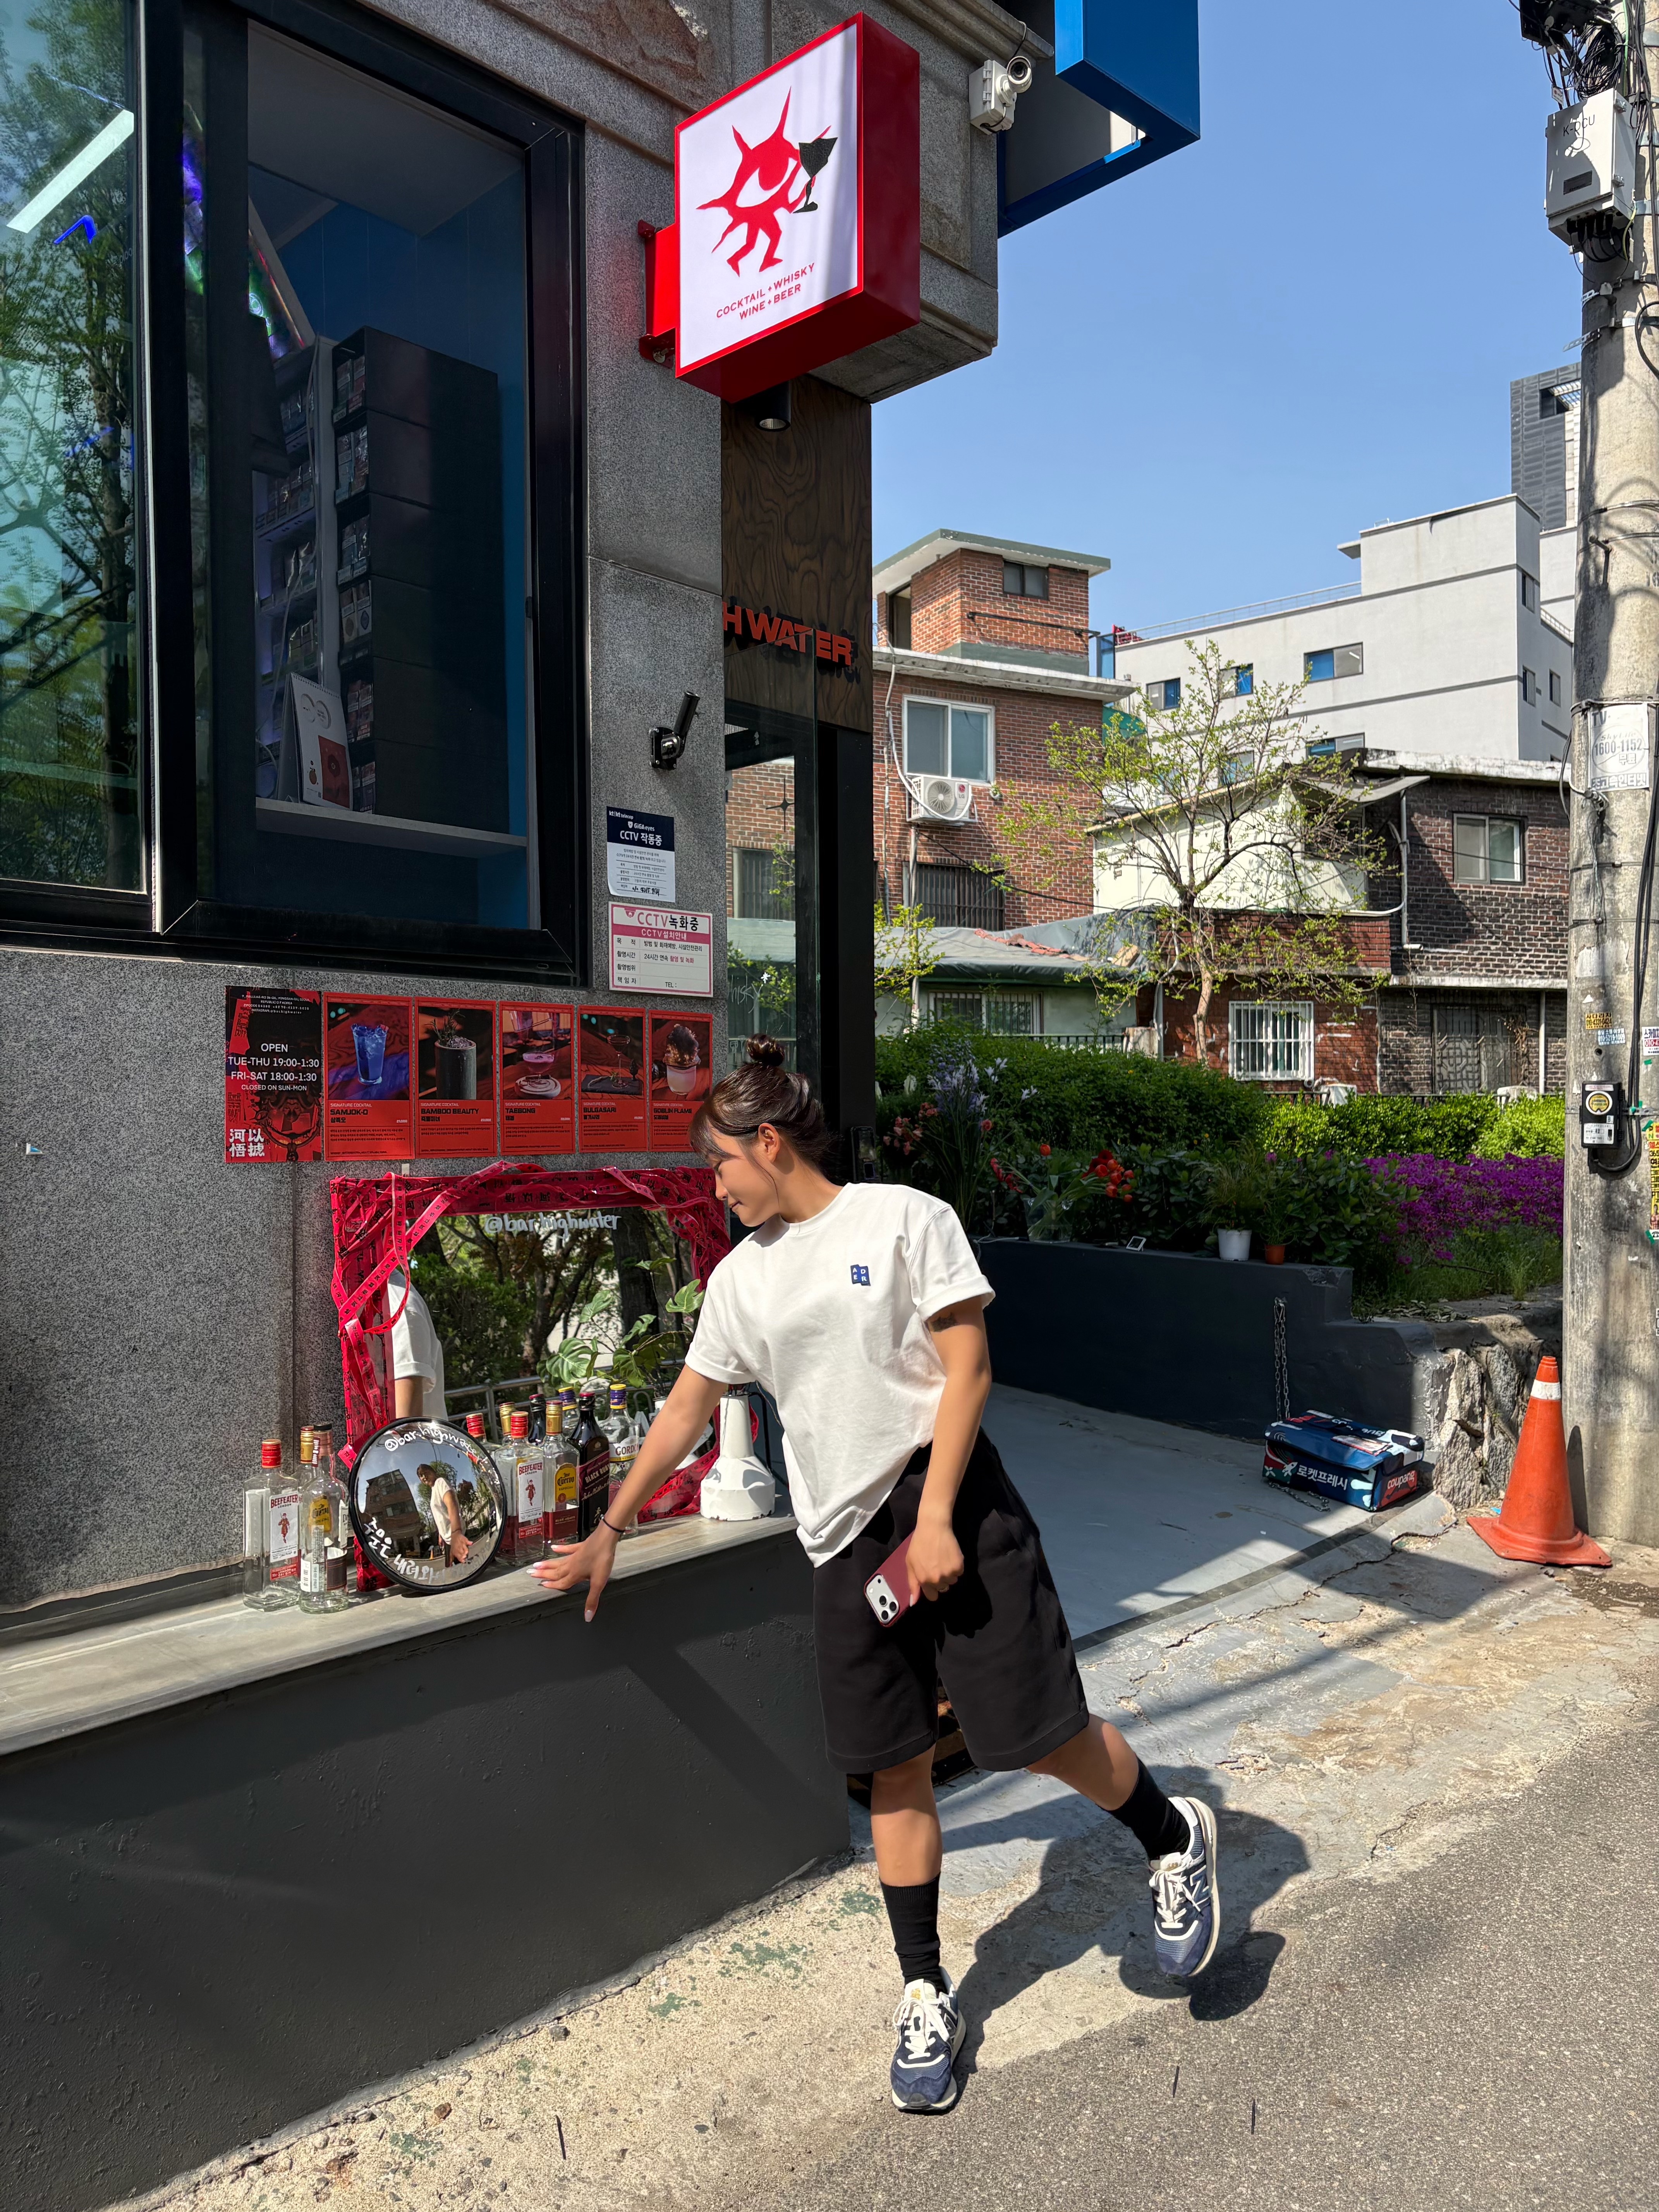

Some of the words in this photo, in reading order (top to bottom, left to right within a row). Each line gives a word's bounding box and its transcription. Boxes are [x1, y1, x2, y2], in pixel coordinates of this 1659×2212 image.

[716, 288, 765, 318] COCKTAIL
[774, 263, 815, 289] WHISKY
[739, 301, 765, 320] WINE
[775, 283, 801, 304] BEER
[1592, 711, 1607, 726] TV
[1595, 738, 1642, 756] 1600-1152
[1592, 774, 1646, 789] 초고속인터넷
[620, 831, 639, 841] CCTV
[641, 833, 662, 846] 작동중
[617, 950, 635, 959] 촬영시간
[678, 944, 702, 952] 시설안전관리
[617, 963, 636, 971] 촬영범위
[728, 974, 763, 1014] hisky
[261, 1043, 288, 1052] OPEN
[228, 1057, 270, 1066] TUE-THU
[273, 1058, 319, 1067] 19:00-1:30
[231, 1071, 268, 1080] FRI-SAT
[270, 1072, 317, 1081] 18:00-1:30
[229, 1128, 264, 1143] 河以
[519, 1462, 543, 1476] BEEFEATER
[585, 1472, 599, 1483] BLACK
[599, 1464, 610, 1475] RUBY
[1297, 1464, 1348, 1491] 로켓프레시
[1387, 1470, 1415, 1489] coupang
[271, 1494, 298, 1509] BEEFEATER
